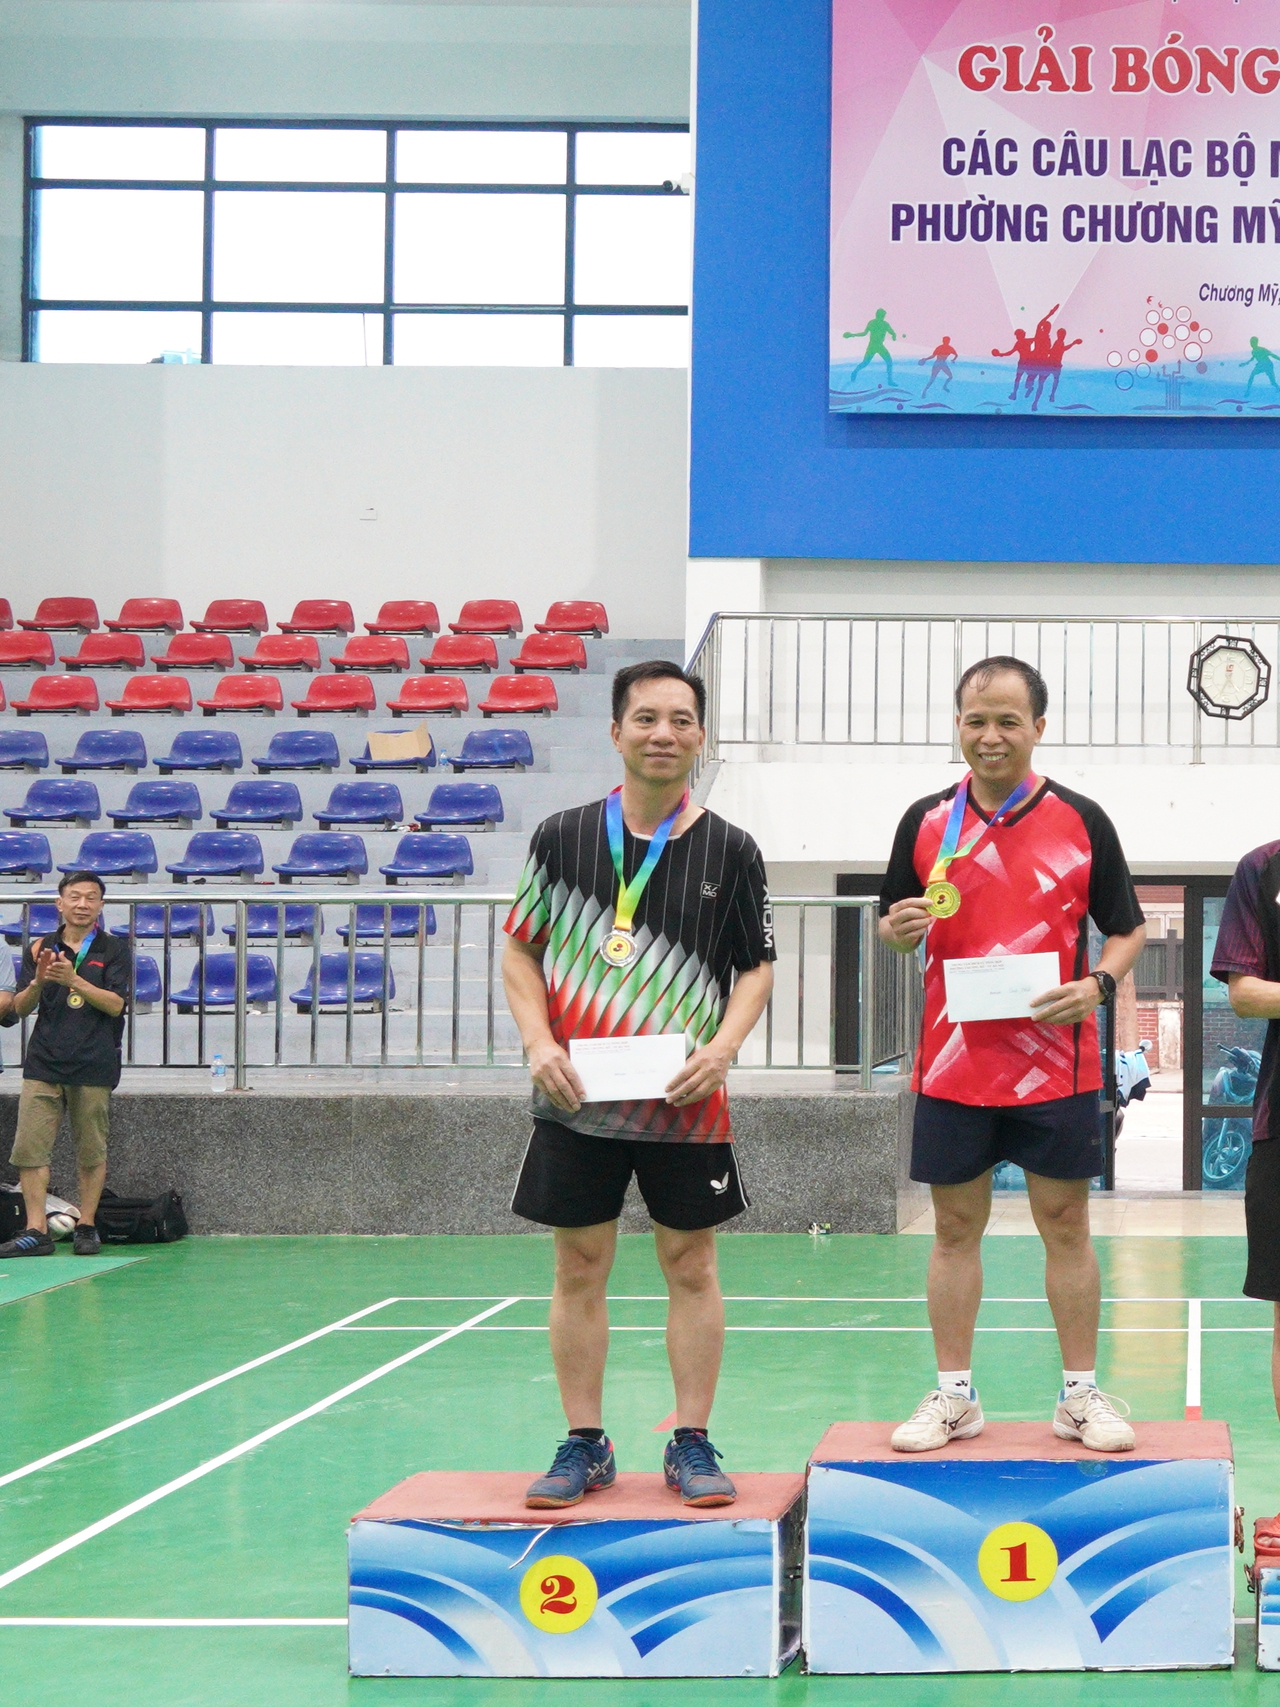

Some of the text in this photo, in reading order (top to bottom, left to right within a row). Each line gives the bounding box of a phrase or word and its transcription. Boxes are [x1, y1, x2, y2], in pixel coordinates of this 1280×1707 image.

[958, 26, 1093, 93] GIẢI
[942, 129, 1018, 177] CÁC
[1032, 130, 1108, 177] CÂU
[1122, 139, 1192, 186] LẠC
[1206, 132, 1256, 187] BỘ
[891, 194, 1048, 243] PHƯỜNG
[1062, 201, 1218, 244] CHƯƠNG
[1198, 283, 1254, 307] Chương
[1001, 1542, 1034, 1582] 1
[540, 1575, 577, 1615] 2
